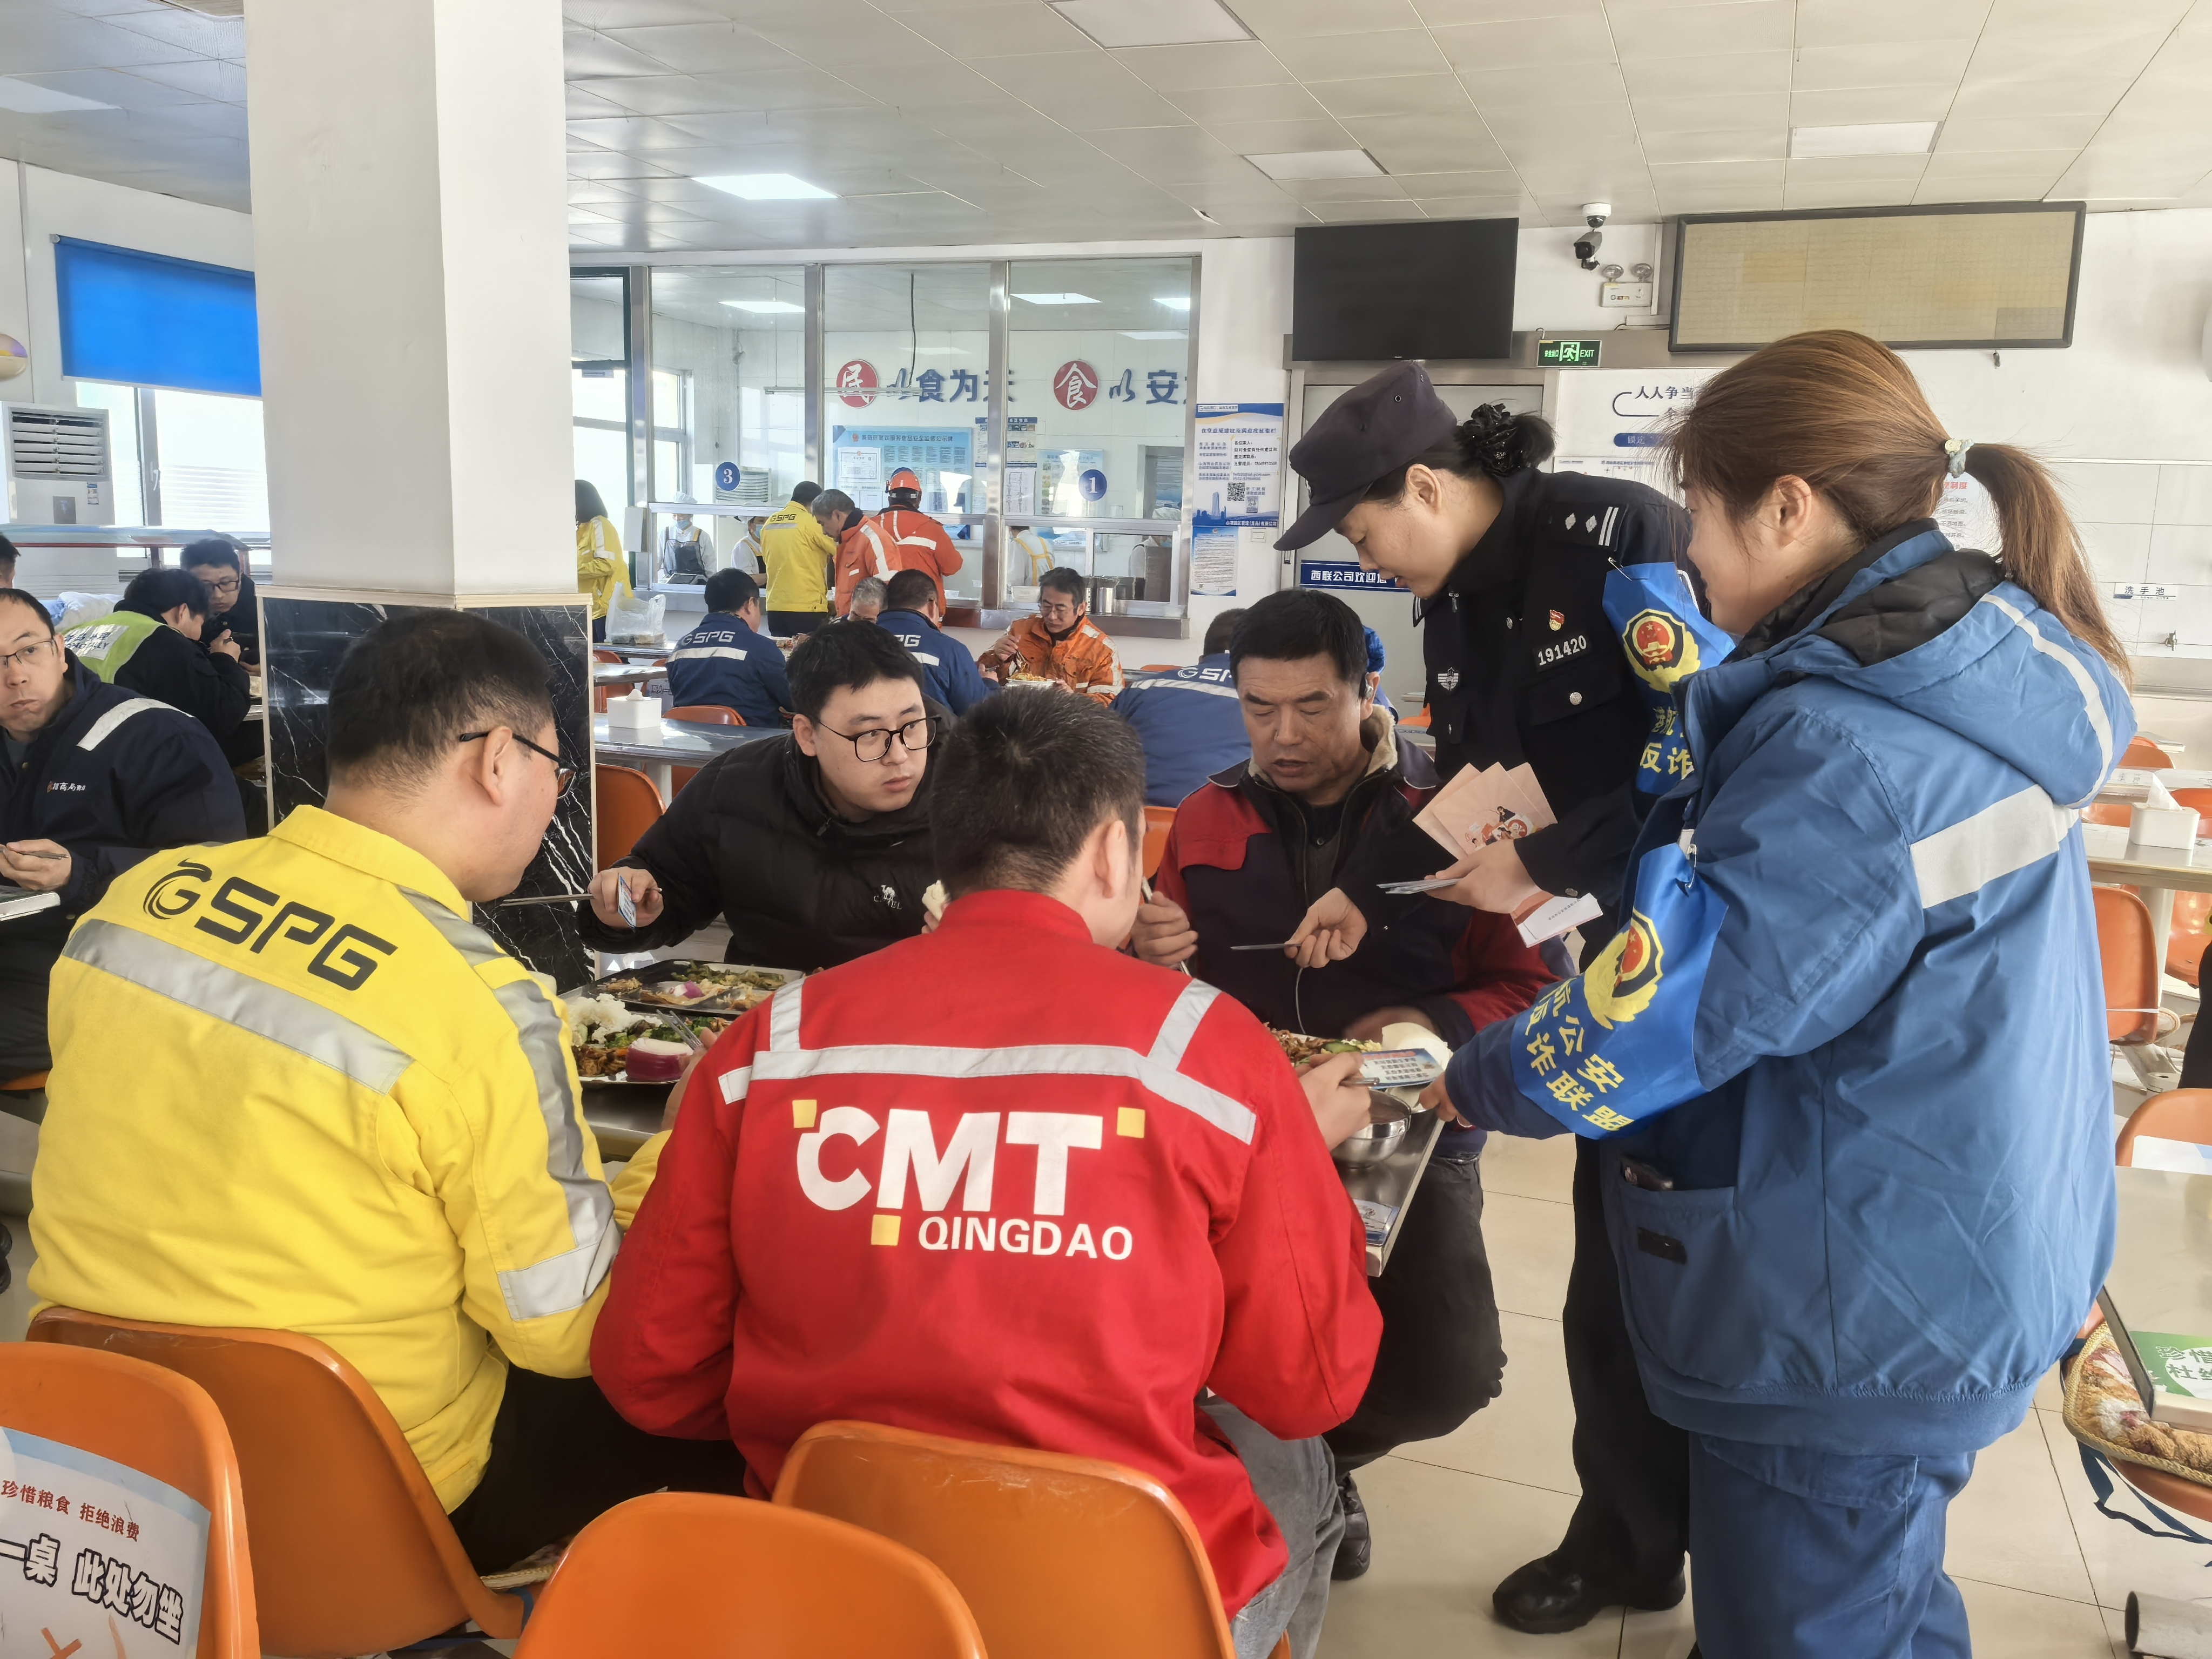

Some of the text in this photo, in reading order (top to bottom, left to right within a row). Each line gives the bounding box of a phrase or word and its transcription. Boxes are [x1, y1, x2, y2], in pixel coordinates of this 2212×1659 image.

[1580, 349, 1595, 358] EXIT
[724, 469, 733, 484] 3
[1088, 477, 1098, 494] 1
[2125, 586, 2164, 595] 洗手池
[1538, 635, 1587, 666] 191420
[1640, 742, 1695, 780] 反诈
[873, 895, 902, 909] CMEL
[796, 1106, 1103, 1216] CMT
[918, 1216, 1133, 1260] QINGDAO
[1, 1480, 140, 1542] 珍惜粮食 拒绝浪费
[71, 1548, 183, 1645] 此处勿坐
